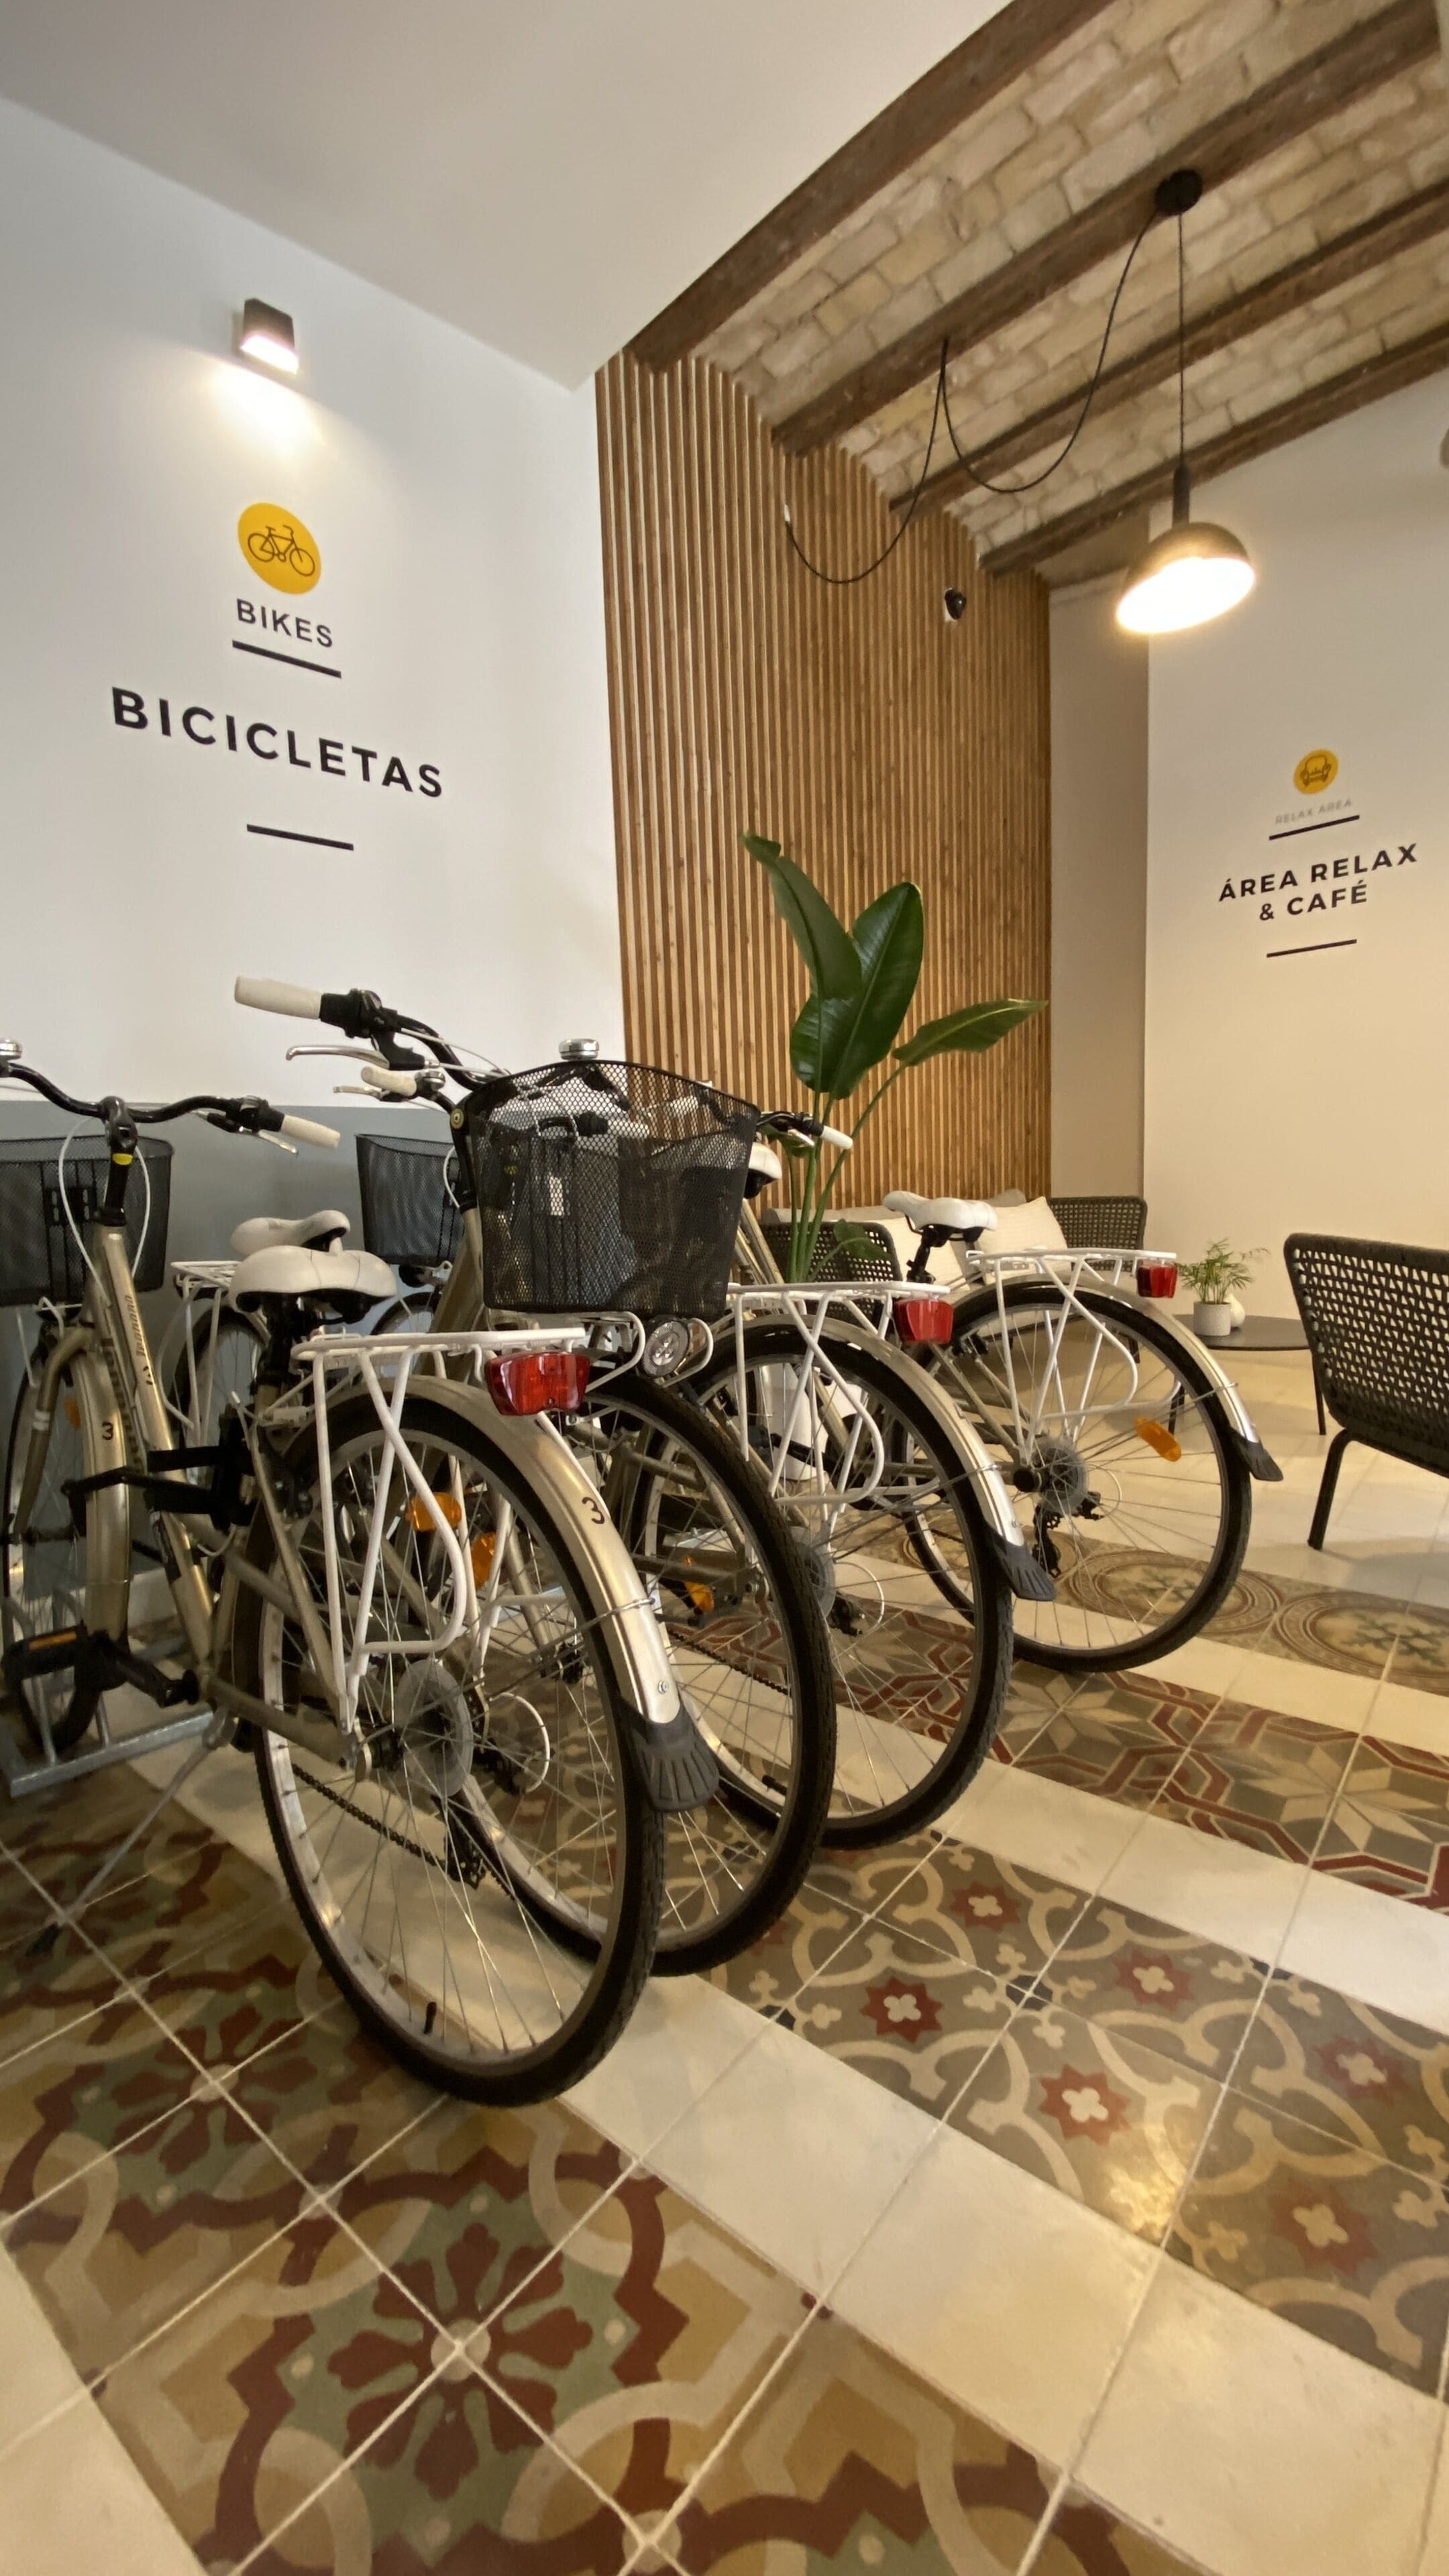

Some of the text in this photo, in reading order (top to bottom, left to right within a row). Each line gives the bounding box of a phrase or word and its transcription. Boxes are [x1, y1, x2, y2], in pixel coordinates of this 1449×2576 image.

[235, 598, 333, 649] BIKES
[111, 686, 443, 798] BICICLETAS
[1275, 797, 1352, 825] RELAX AREA
[1218, 843, 1417, 902] ÁREA RELAX
[1258, 879, 1368, 922] & CAFÉ
[101, 1421, 114, 1441] 3
[582, 1496, 606, 1525] 3
